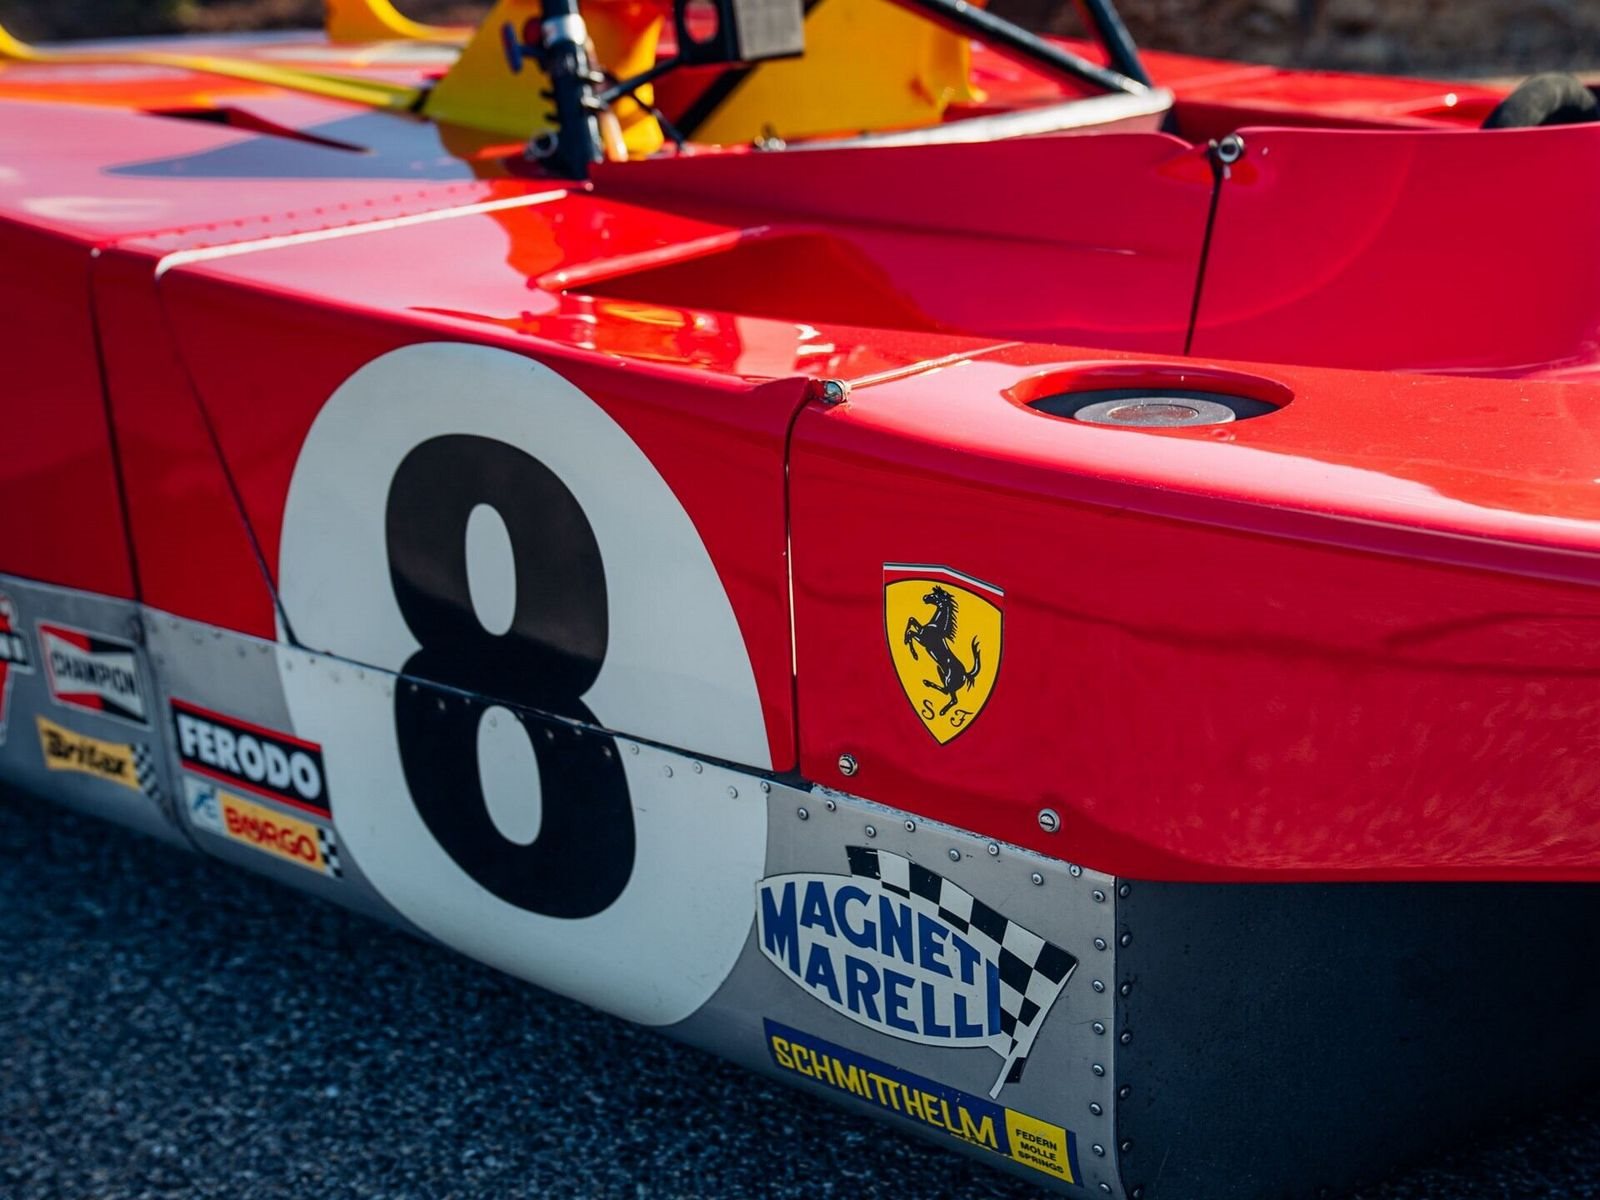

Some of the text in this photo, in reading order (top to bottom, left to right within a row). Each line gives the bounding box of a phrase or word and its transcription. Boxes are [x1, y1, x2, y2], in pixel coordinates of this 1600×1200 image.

[52, 651, 136, 695] CHAMPION
[385, 433, 636, 920] 8
[921, 699, 935, 720] S
[48, 729, 125, 774] Britax
[177, 713, 321, 800] FERODO
[761, 880, 1001, 990] MAGNETI
[771, 1035, 998, 1149] SCHMITTHELM
[1015, 1128, 1057, 1151] FEDERN
[1020, 1141, 1057, 1161] MOLLE
[1018, 1150, 1064, 1174] SPRINGS
